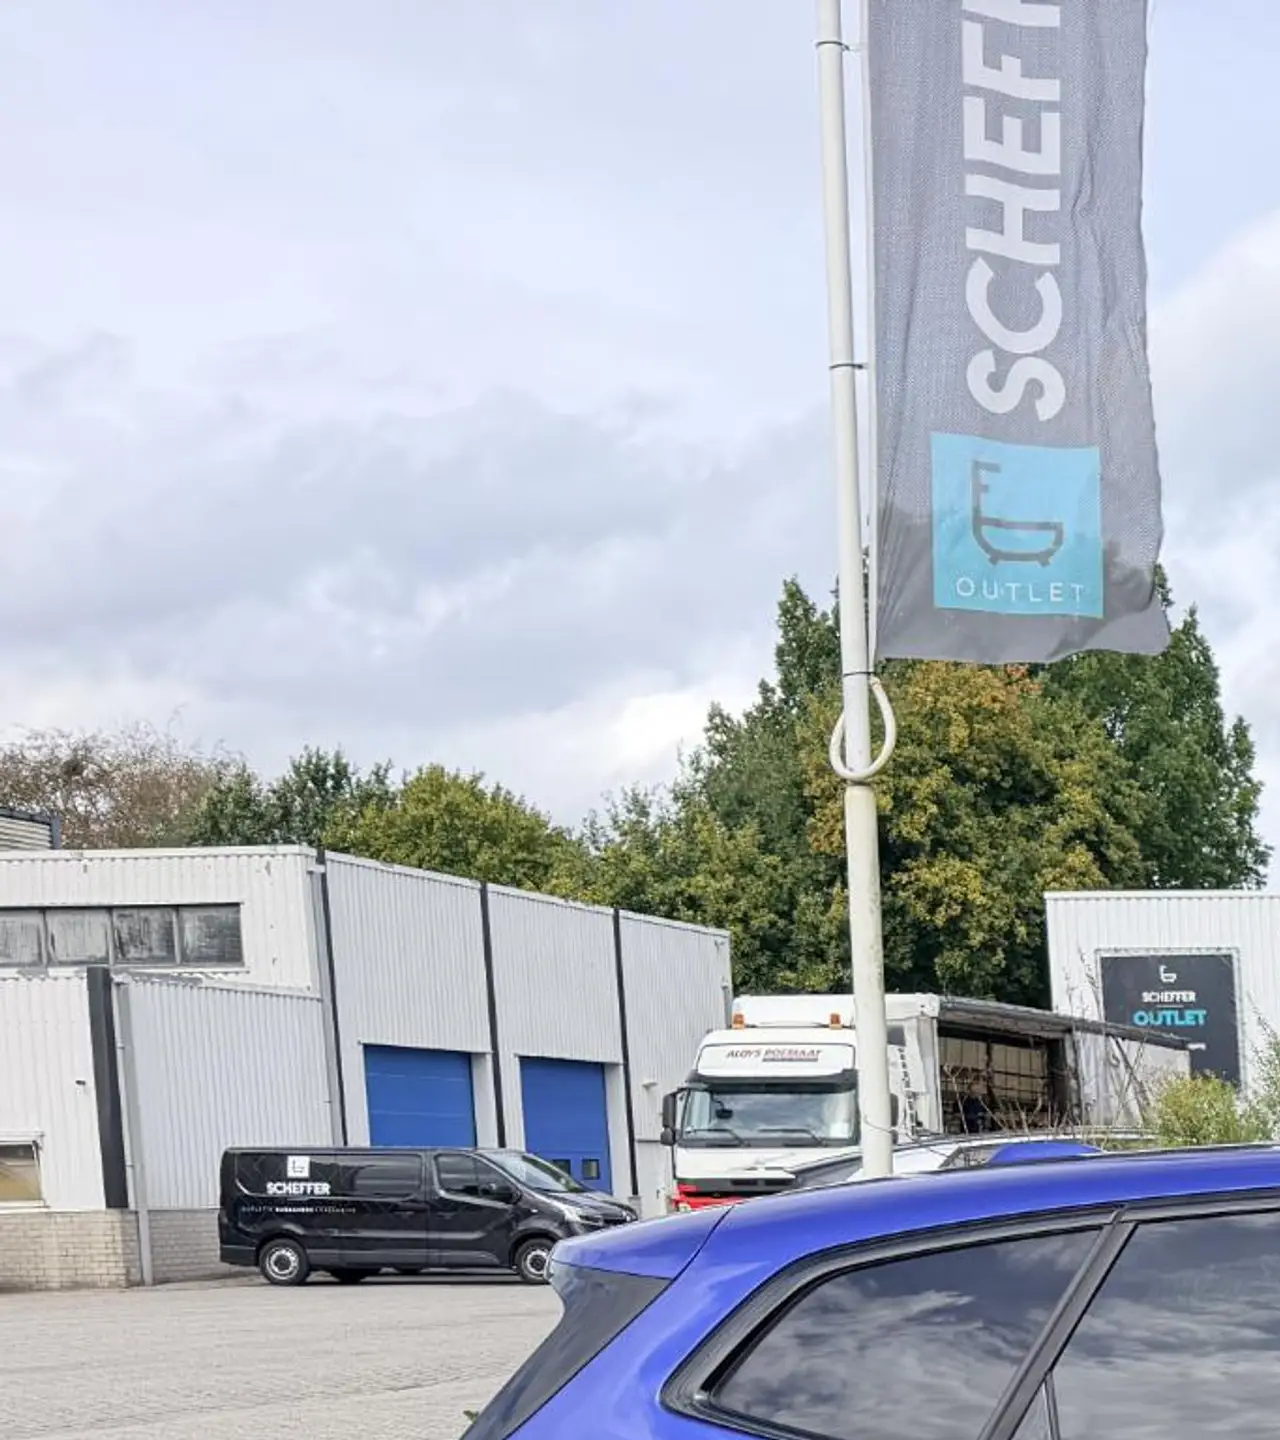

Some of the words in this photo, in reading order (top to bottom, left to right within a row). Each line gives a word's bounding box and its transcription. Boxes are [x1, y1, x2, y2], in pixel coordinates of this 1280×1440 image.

[956, 577, 1084, 603] OUTLET
[1142, 991, 1196, 1002] SCHEFFER
[1133, 1010, 1207, 1026] OUTLET
[266, 1181, 331, 1195] SCHEFFER
